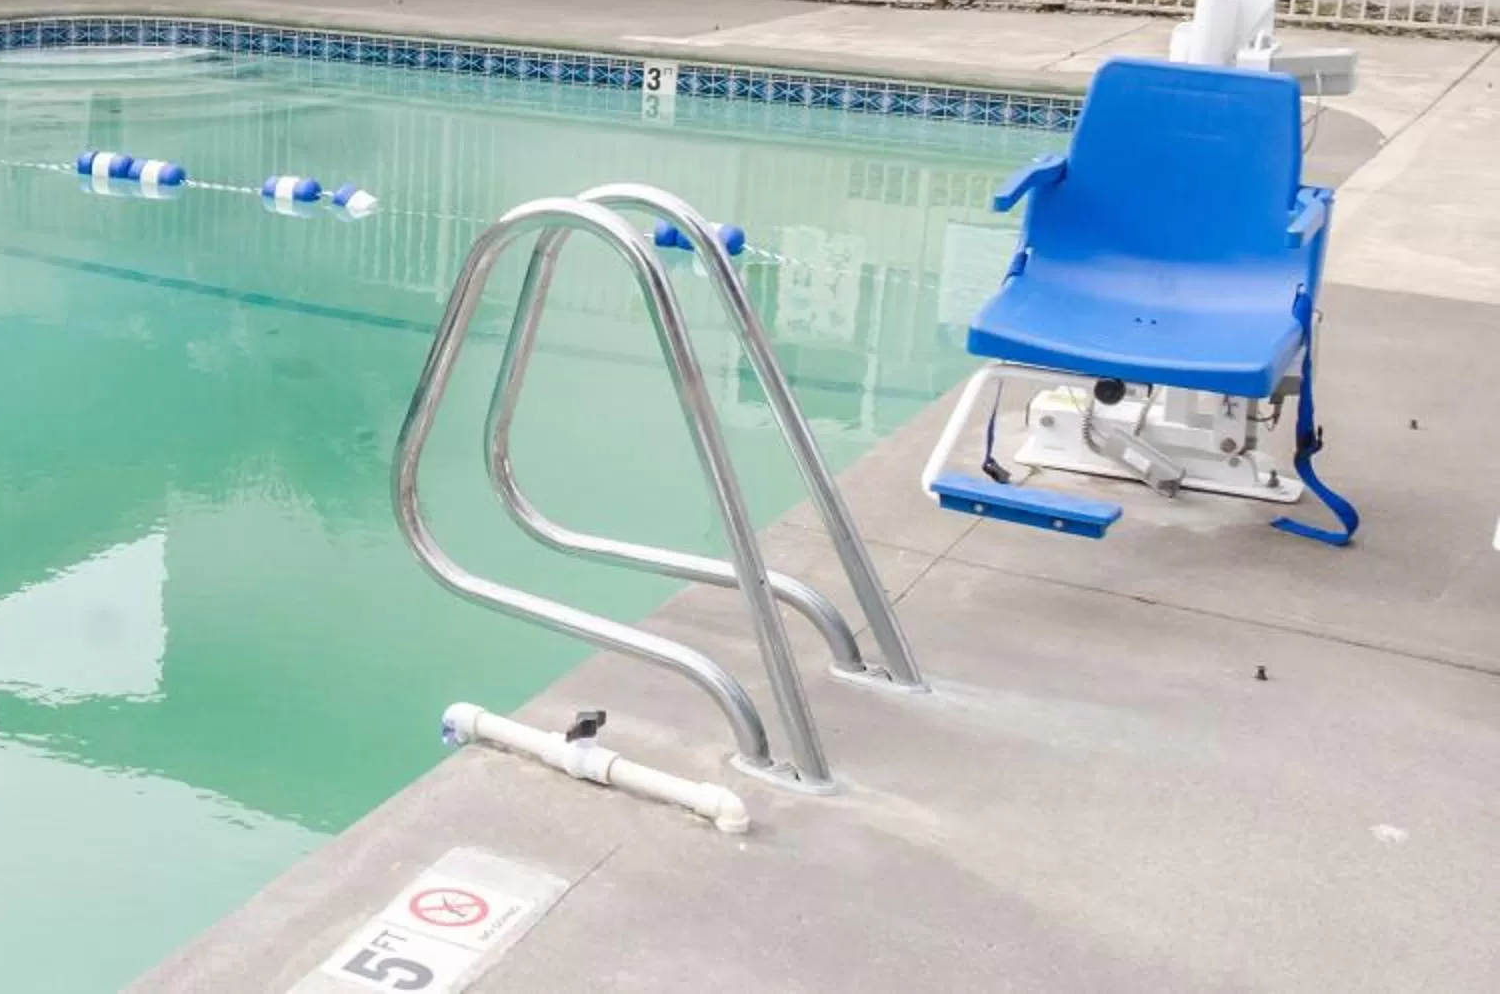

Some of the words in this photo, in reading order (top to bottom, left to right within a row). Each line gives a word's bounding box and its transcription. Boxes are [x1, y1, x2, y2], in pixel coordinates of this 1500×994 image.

[647, 67, 660, 91] 3
[369, 928, 408, 952] FT
[340, 947, 434, 991] 5
